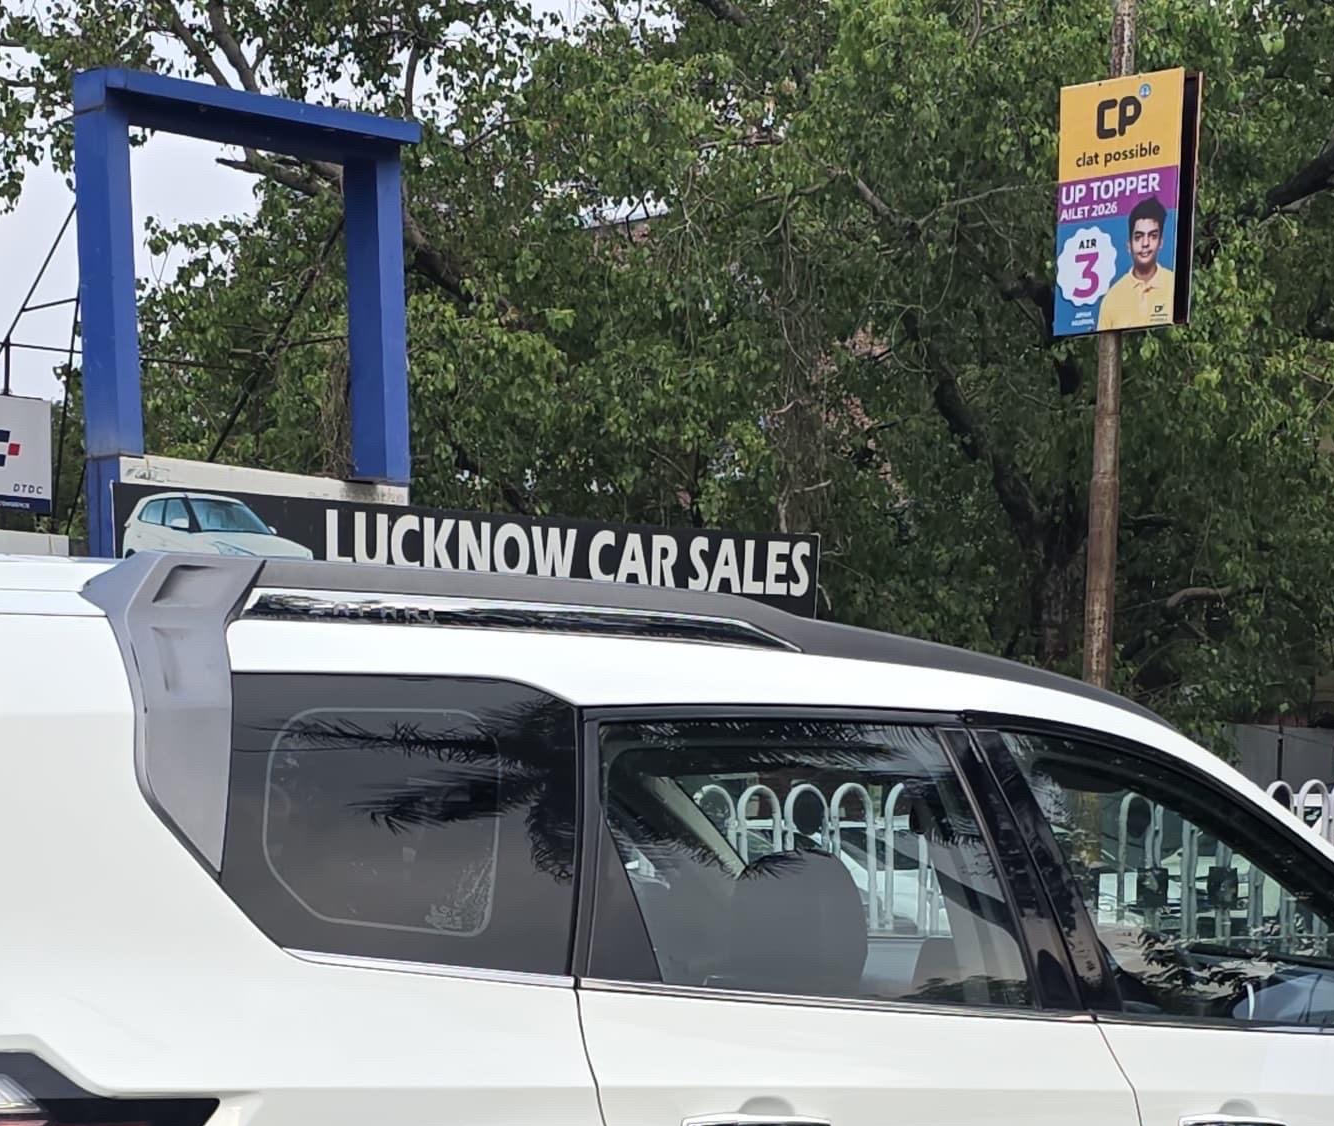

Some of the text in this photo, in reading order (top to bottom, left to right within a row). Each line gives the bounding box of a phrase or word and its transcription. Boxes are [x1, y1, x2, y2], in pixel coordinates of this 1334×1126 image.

[1096, 96, 1142, 140] CP
[1076, 141, 1160, 168] clat possible
[1062, 173, 1160, 205] UP TOPPER
[1060, 203, 1117, 222] AILET 2026
[1078, 239, 1097, 250] AIR
[1073, 252, 1100, 299] 3
[13, 483, 43, 495] DTDC
[325, 508, 811, 599] LUCKNOW CAR SALES
